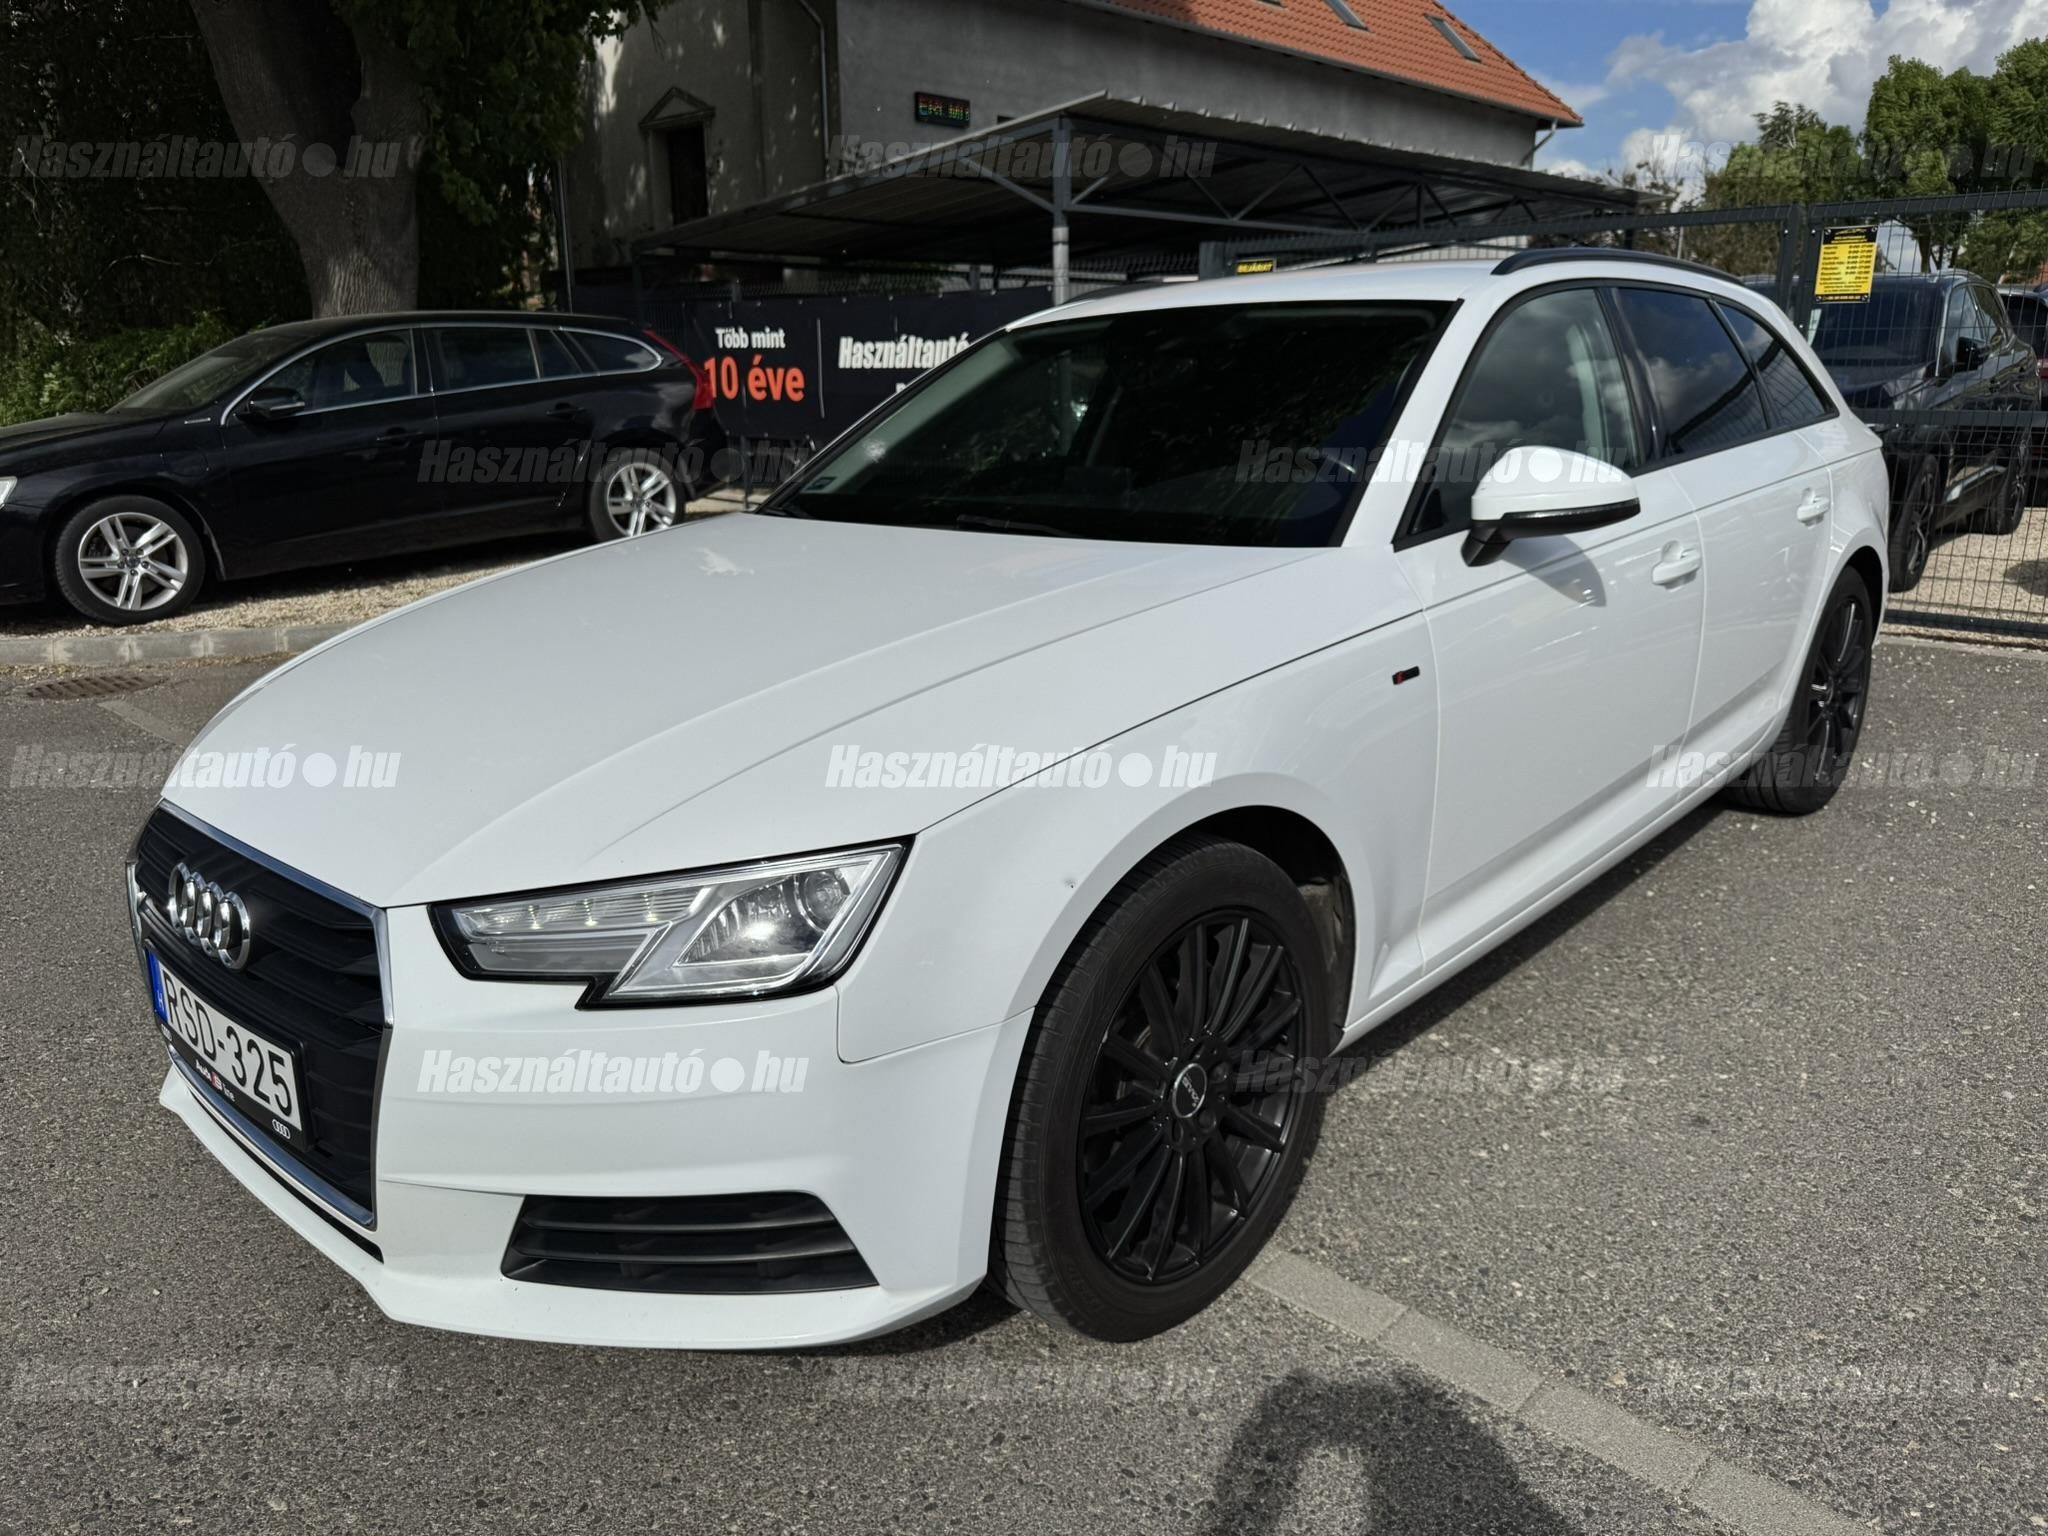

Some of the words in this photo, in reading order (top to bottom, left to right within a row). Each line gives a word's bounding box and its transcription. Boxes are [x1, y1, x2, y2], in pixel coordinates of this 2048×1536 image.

[715, 326, 749, 348] Több
[751, 326, 786, 348] mint
[704, 356, 739, 399] 10
[747, 354, 805, 401] éve
[162, 969, 293, 1117] RSD-325
